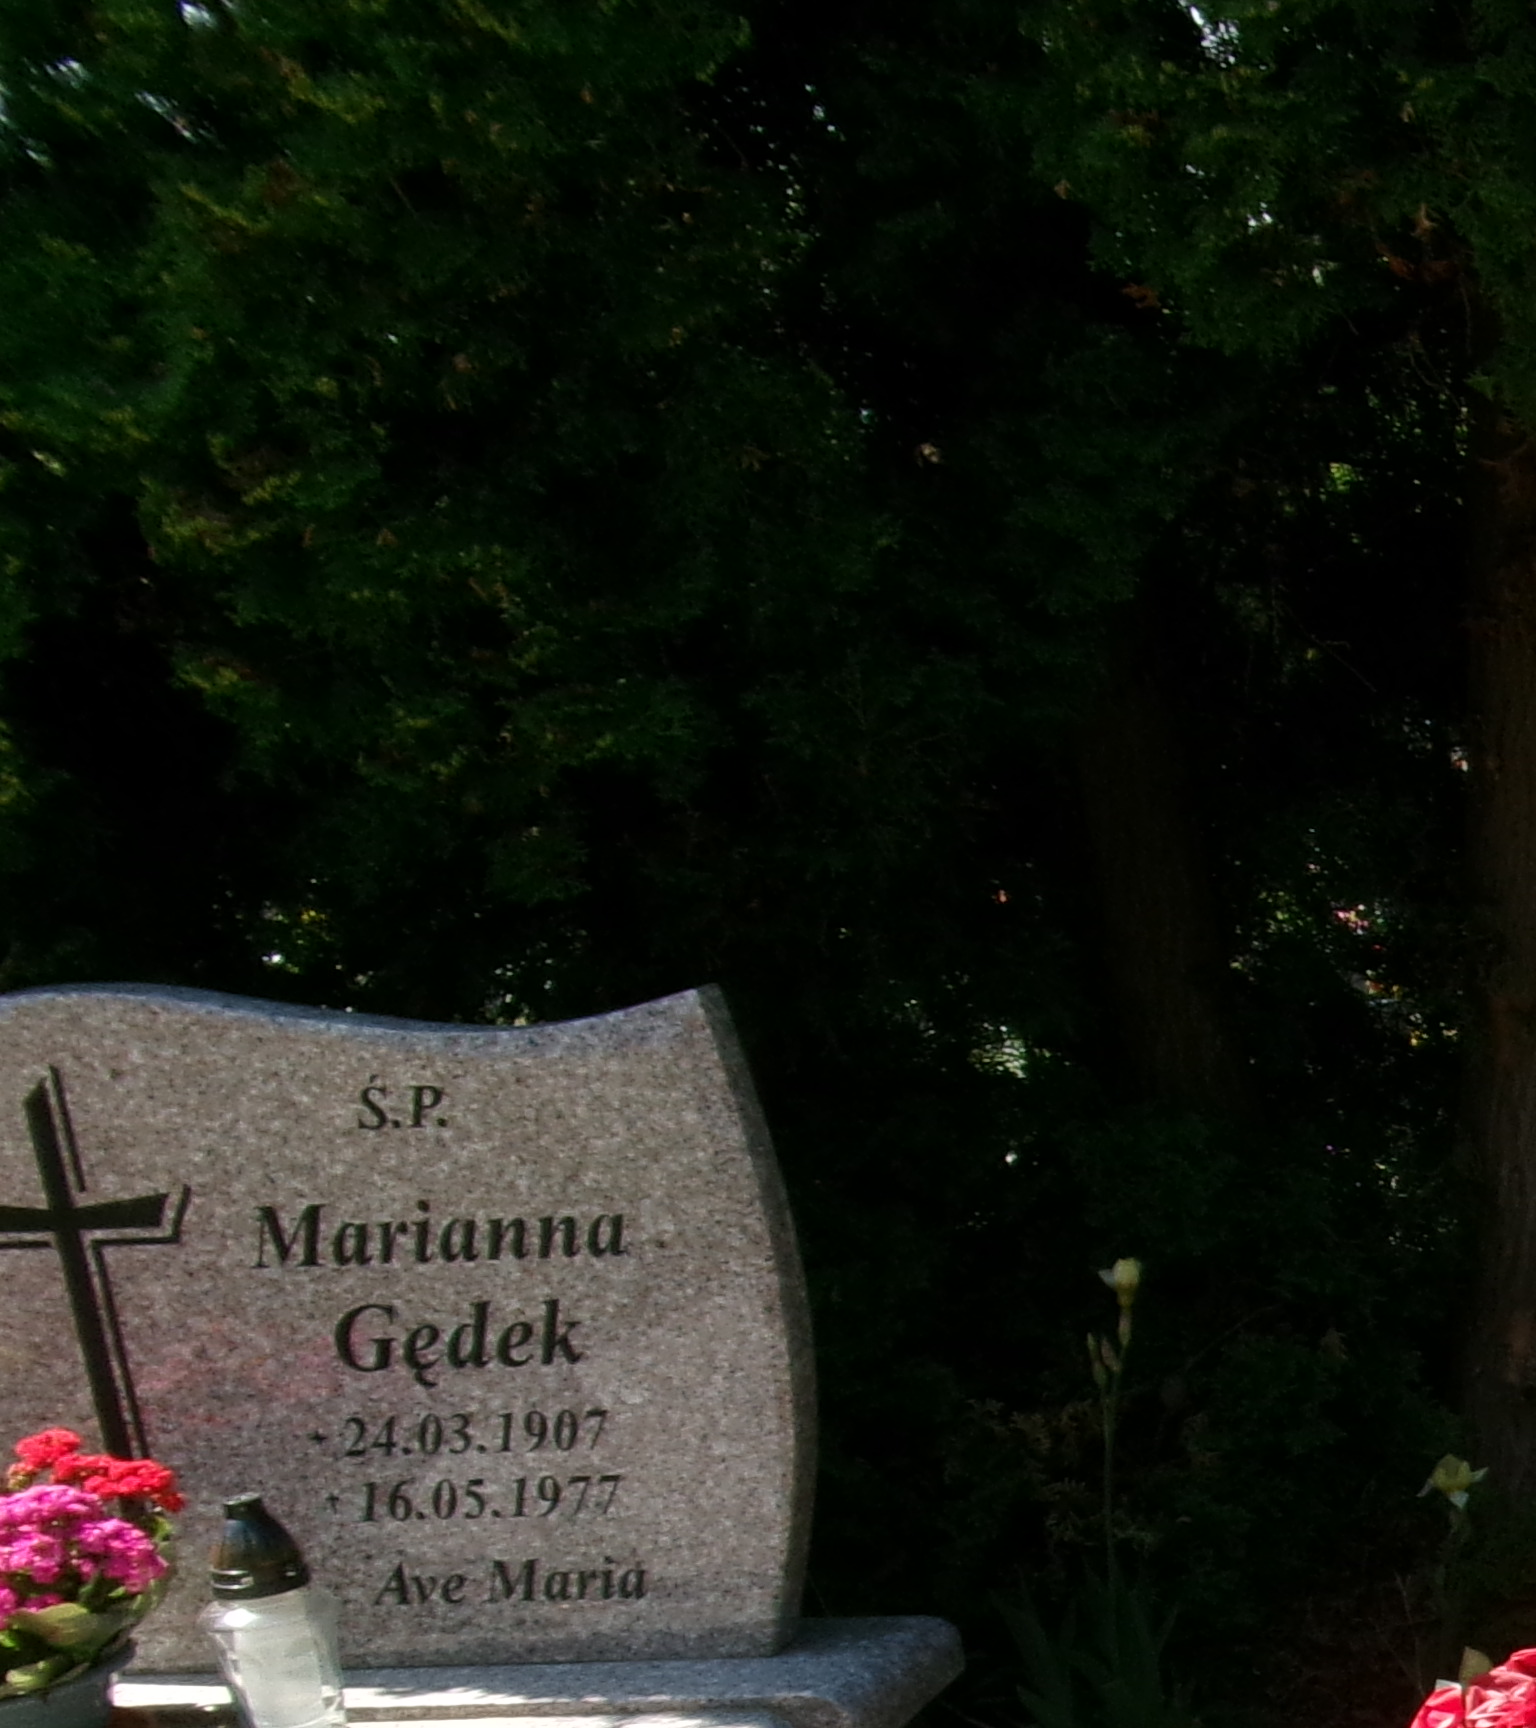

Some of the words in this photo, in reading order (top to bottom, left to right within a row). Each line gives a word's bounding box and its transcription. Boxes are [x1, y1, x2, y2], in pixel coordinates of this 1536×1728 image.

[357, 1075, 449, 1130] Ś.P.
[252, 1201, 628, 1269] Marianna
[334, 1298, 585, 1387] Gędek
[344, 1409, 609, 1457] 24.03.1907
[359, 1473, 623, 1523] 16.05.1977
[374, 1561, 468, 1606] Ave
[483, 1555, 649, 1603] Maria
